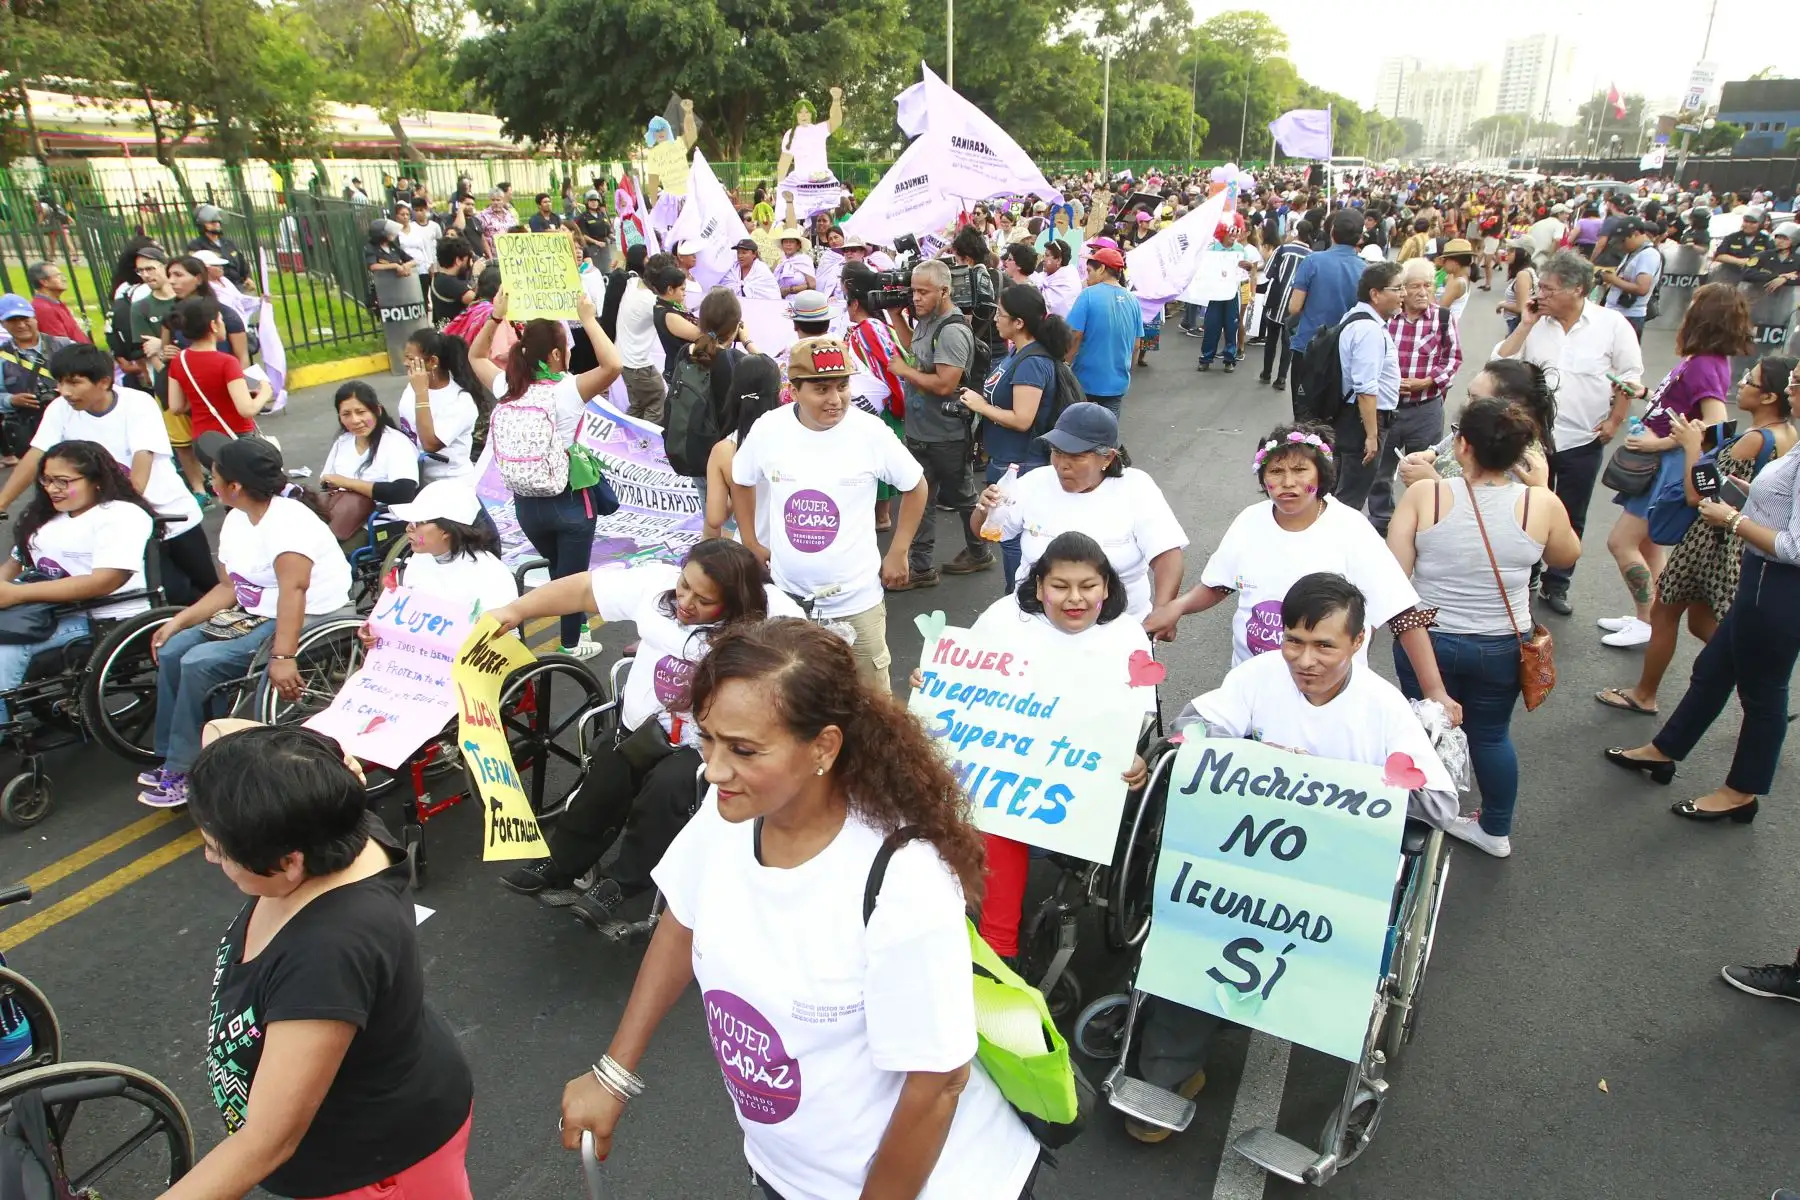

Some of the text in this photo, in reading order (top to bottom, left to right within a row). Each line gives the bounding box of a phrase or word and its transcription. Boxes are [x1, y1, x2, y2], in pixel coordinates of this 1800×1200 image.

[502, 256, 567, 275] FEMINISTAS
[513, 274, 566, 290] de MUJERES
[1660, 275, 1700, 287] OLICIA
[644, 488, 658, 509] LA
[660, 491, 702, 513] EXPLOT
[791, 498, 829, 513] MUJER
[797, 513, 837, 528] CAPAZ
[461, 631, 510, 676] MUJER:
[932, 638, 1029, 676] MUJER:
[927, 709, 1102, 771] Supera tus
[951, 760, 1075, 824] MITES
[1219, 815, 1307, 861] NO
[1170, 861, 1333, 943] IGUALDAD
[709, 1000, 771, 1062] MUJER
[721, 1040, 794, 1090] CAPAZ
